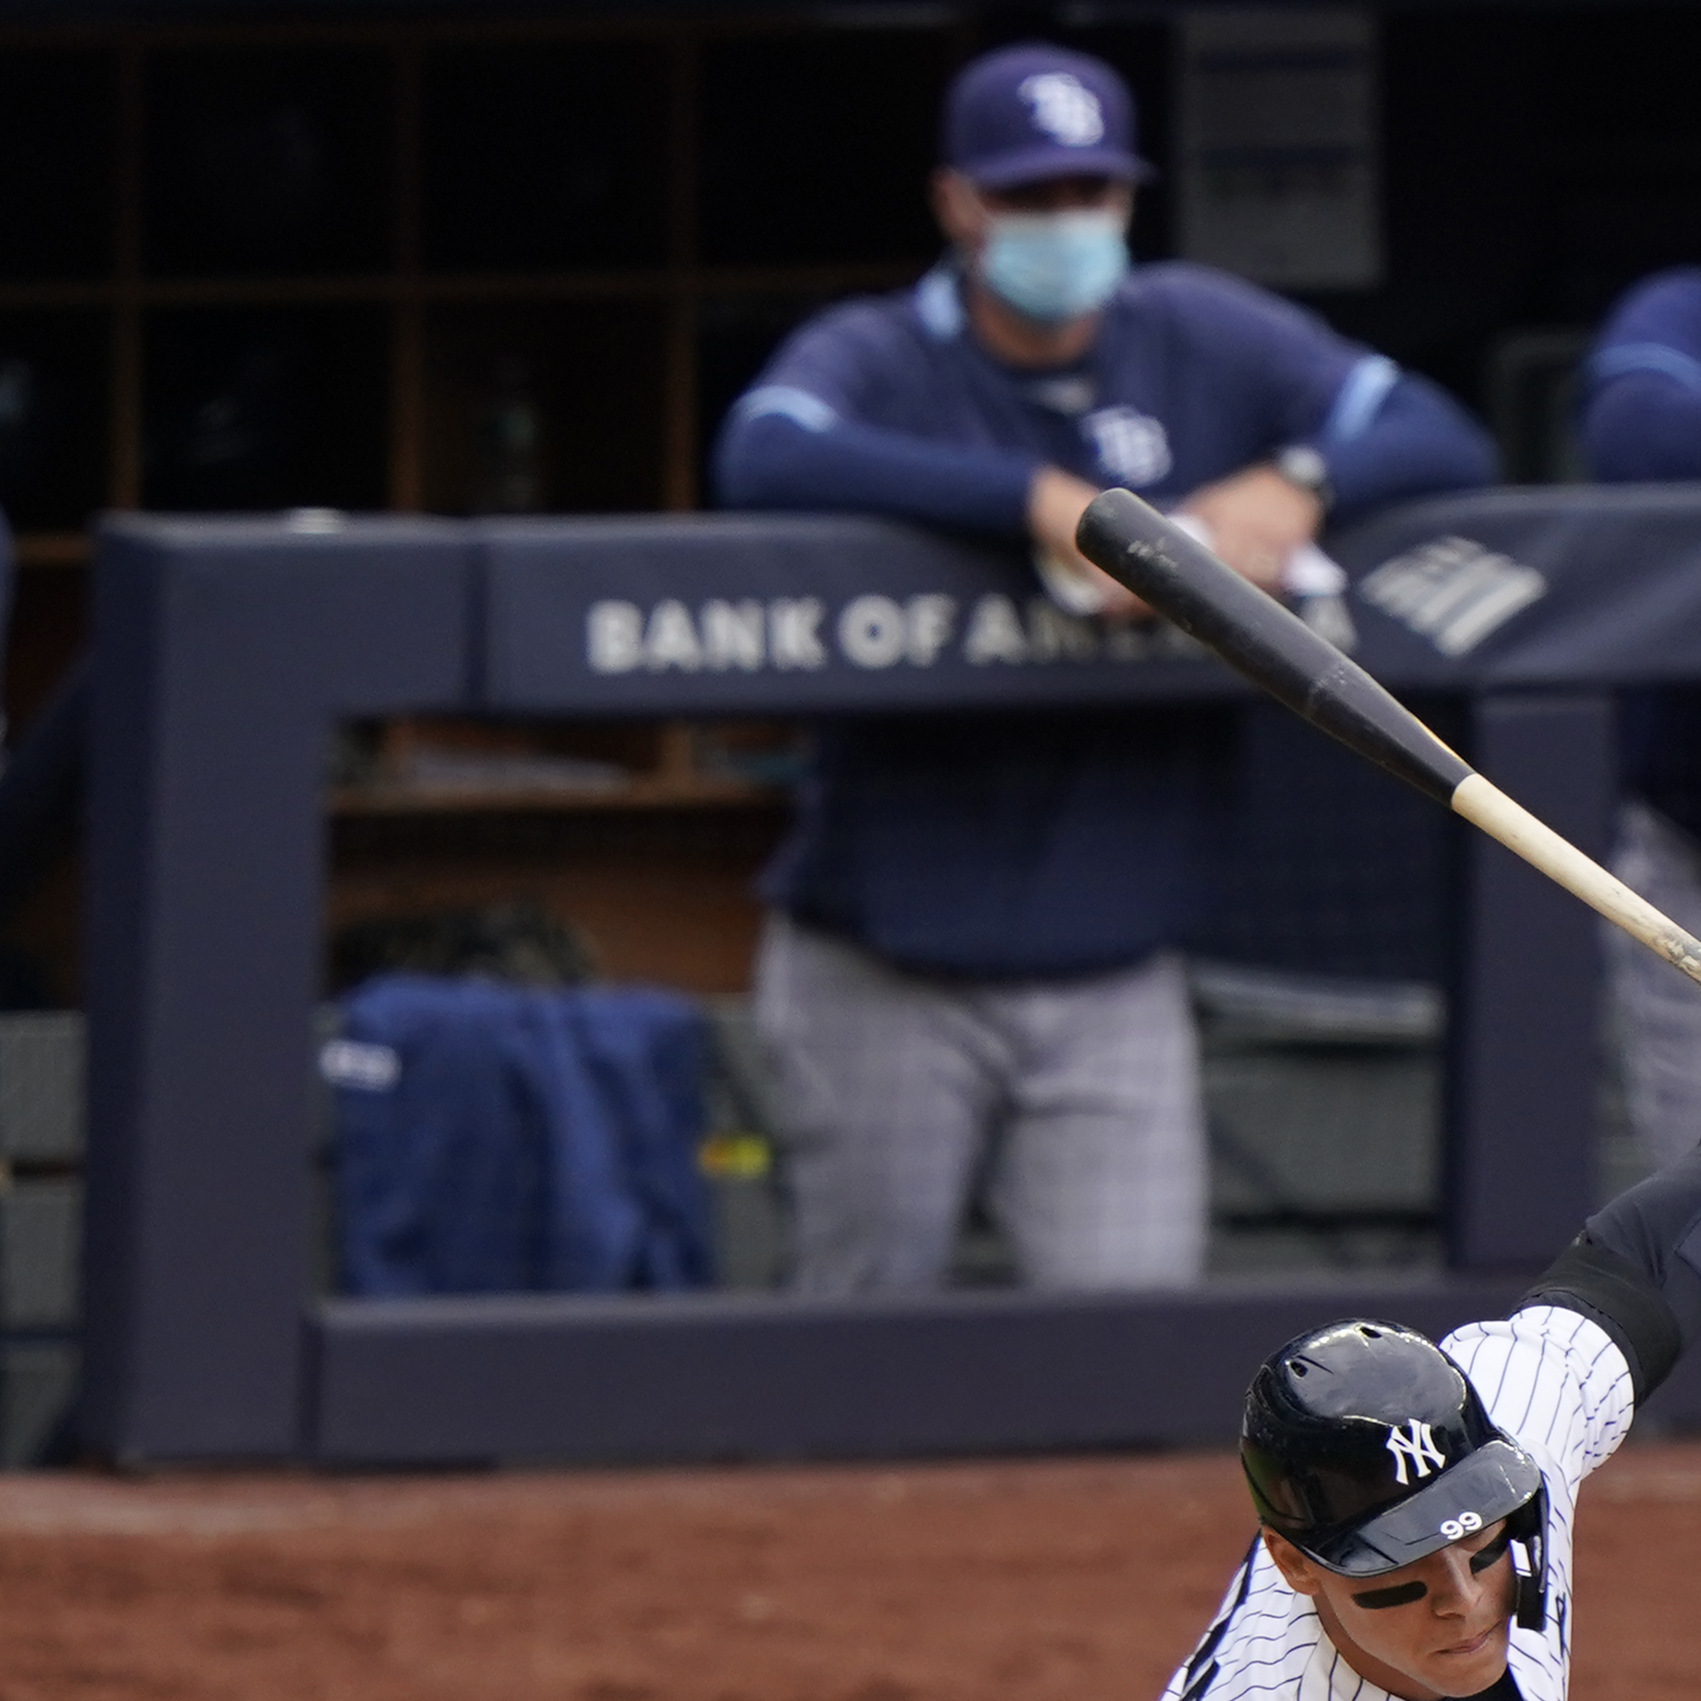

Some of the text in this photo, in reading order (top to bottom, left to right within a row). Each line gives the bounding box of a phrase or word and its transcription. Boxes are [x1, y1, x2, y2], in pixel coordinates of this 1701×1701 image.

[585, 598, 826, 672] BANK
[839, 594, 956, 668] OF
[1440, 1511, 1483, 1541] 99
